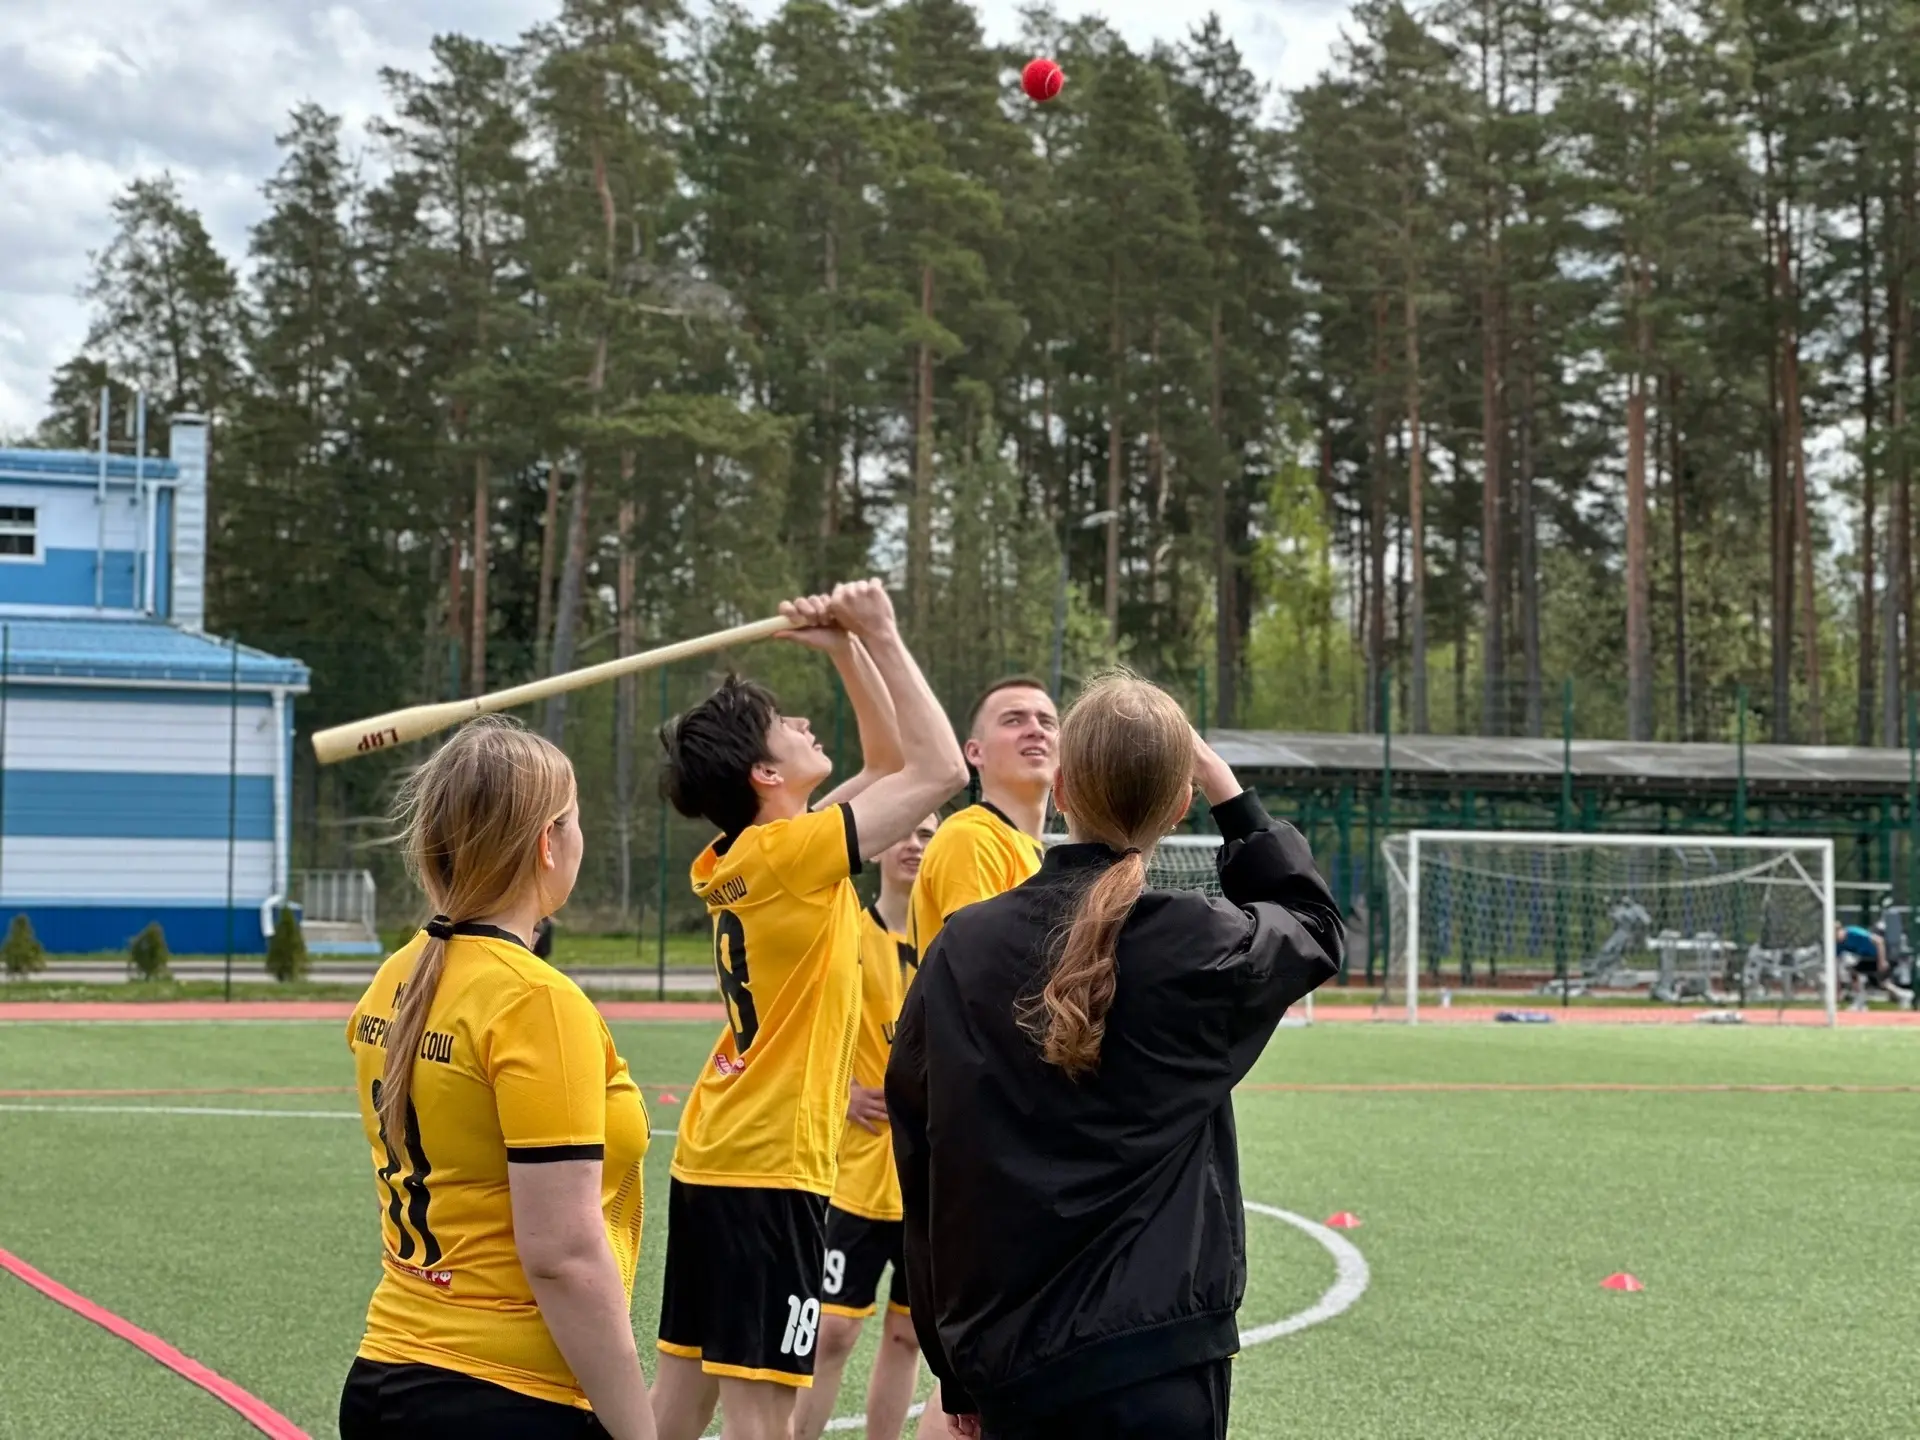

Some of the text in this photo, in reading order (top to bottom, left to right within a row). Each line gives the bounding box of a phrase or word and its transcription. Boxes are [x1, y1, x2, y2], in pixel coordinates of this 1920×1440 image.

[420, 1031, 454, 1064] СОШ
[823, 1248, 846, 1295] 9
[780, 1294, 820, 1357] 18
